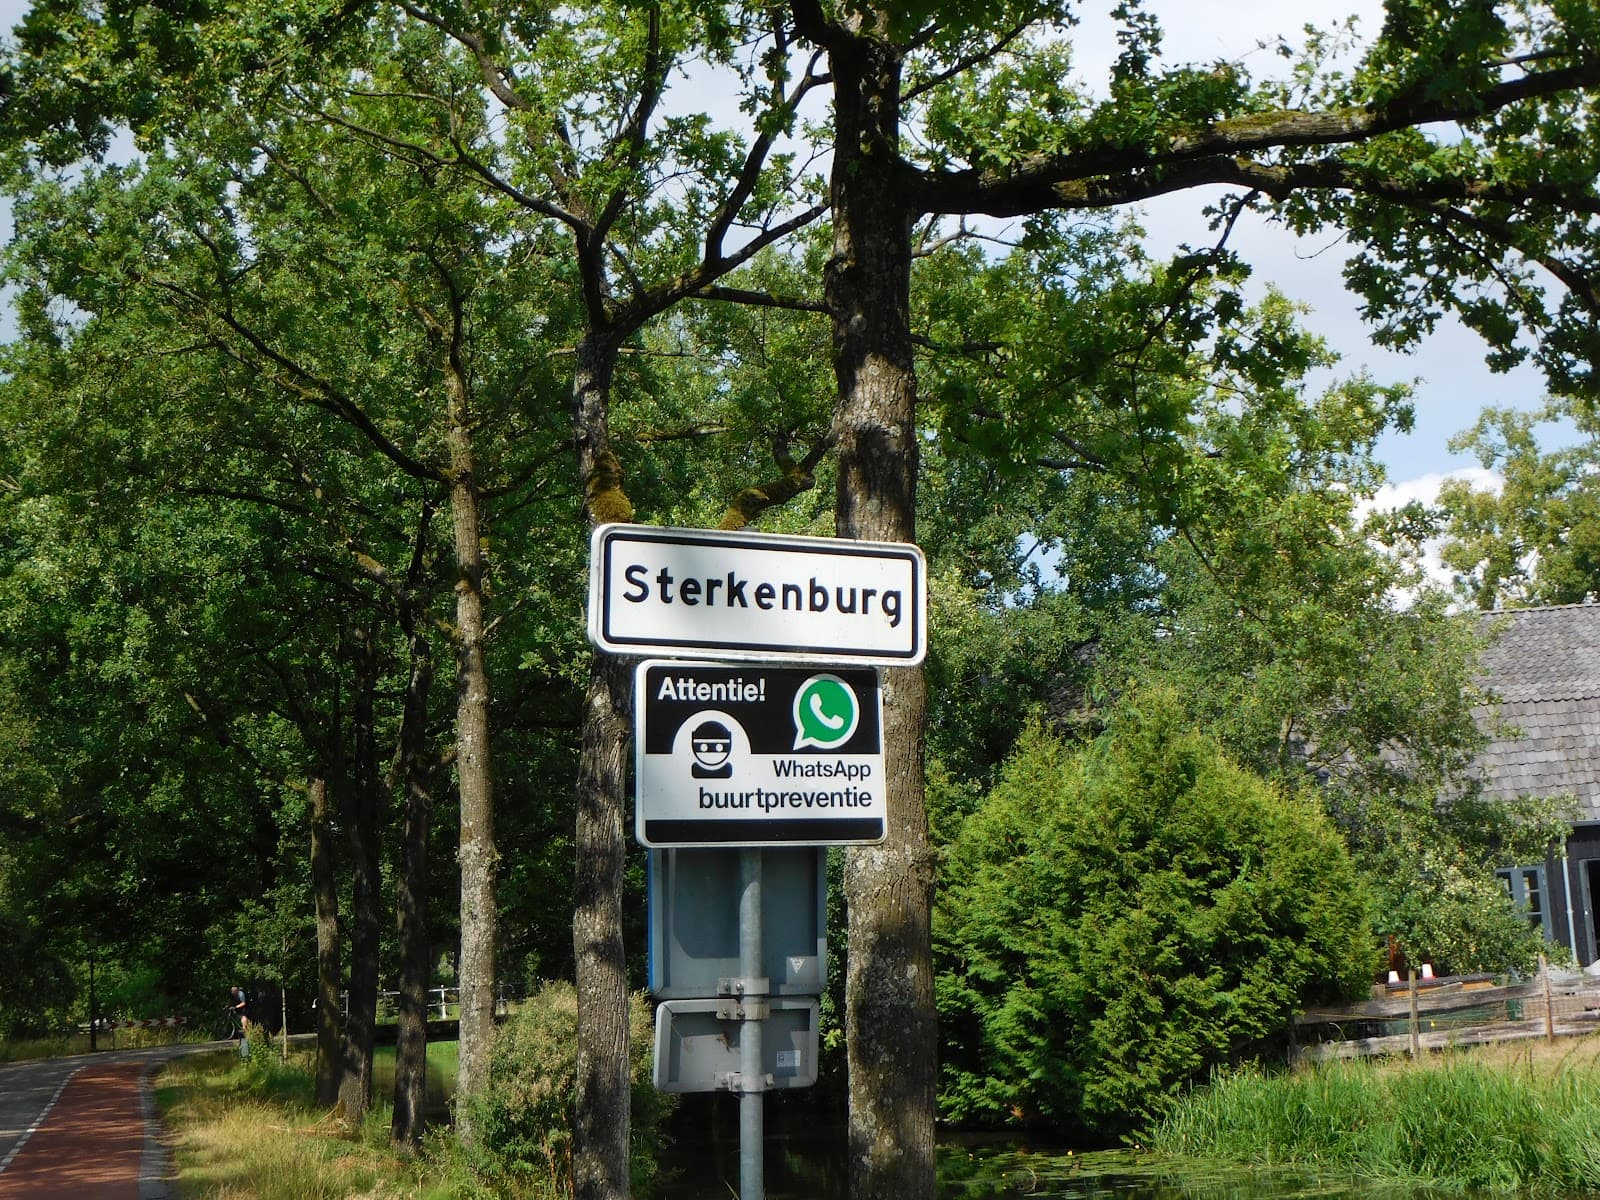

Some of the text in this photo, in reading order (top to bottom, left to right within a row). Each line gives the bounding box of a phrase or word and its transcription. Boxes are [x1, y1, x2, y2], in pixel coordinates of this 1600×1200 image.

[623, 564, 902, 627] Sterkenburg
[658, 676, 766, 702] Attentie!
[773, 759, 871, 781] WhatsApp
[699, 787, 872, 813] buurtpreventie
